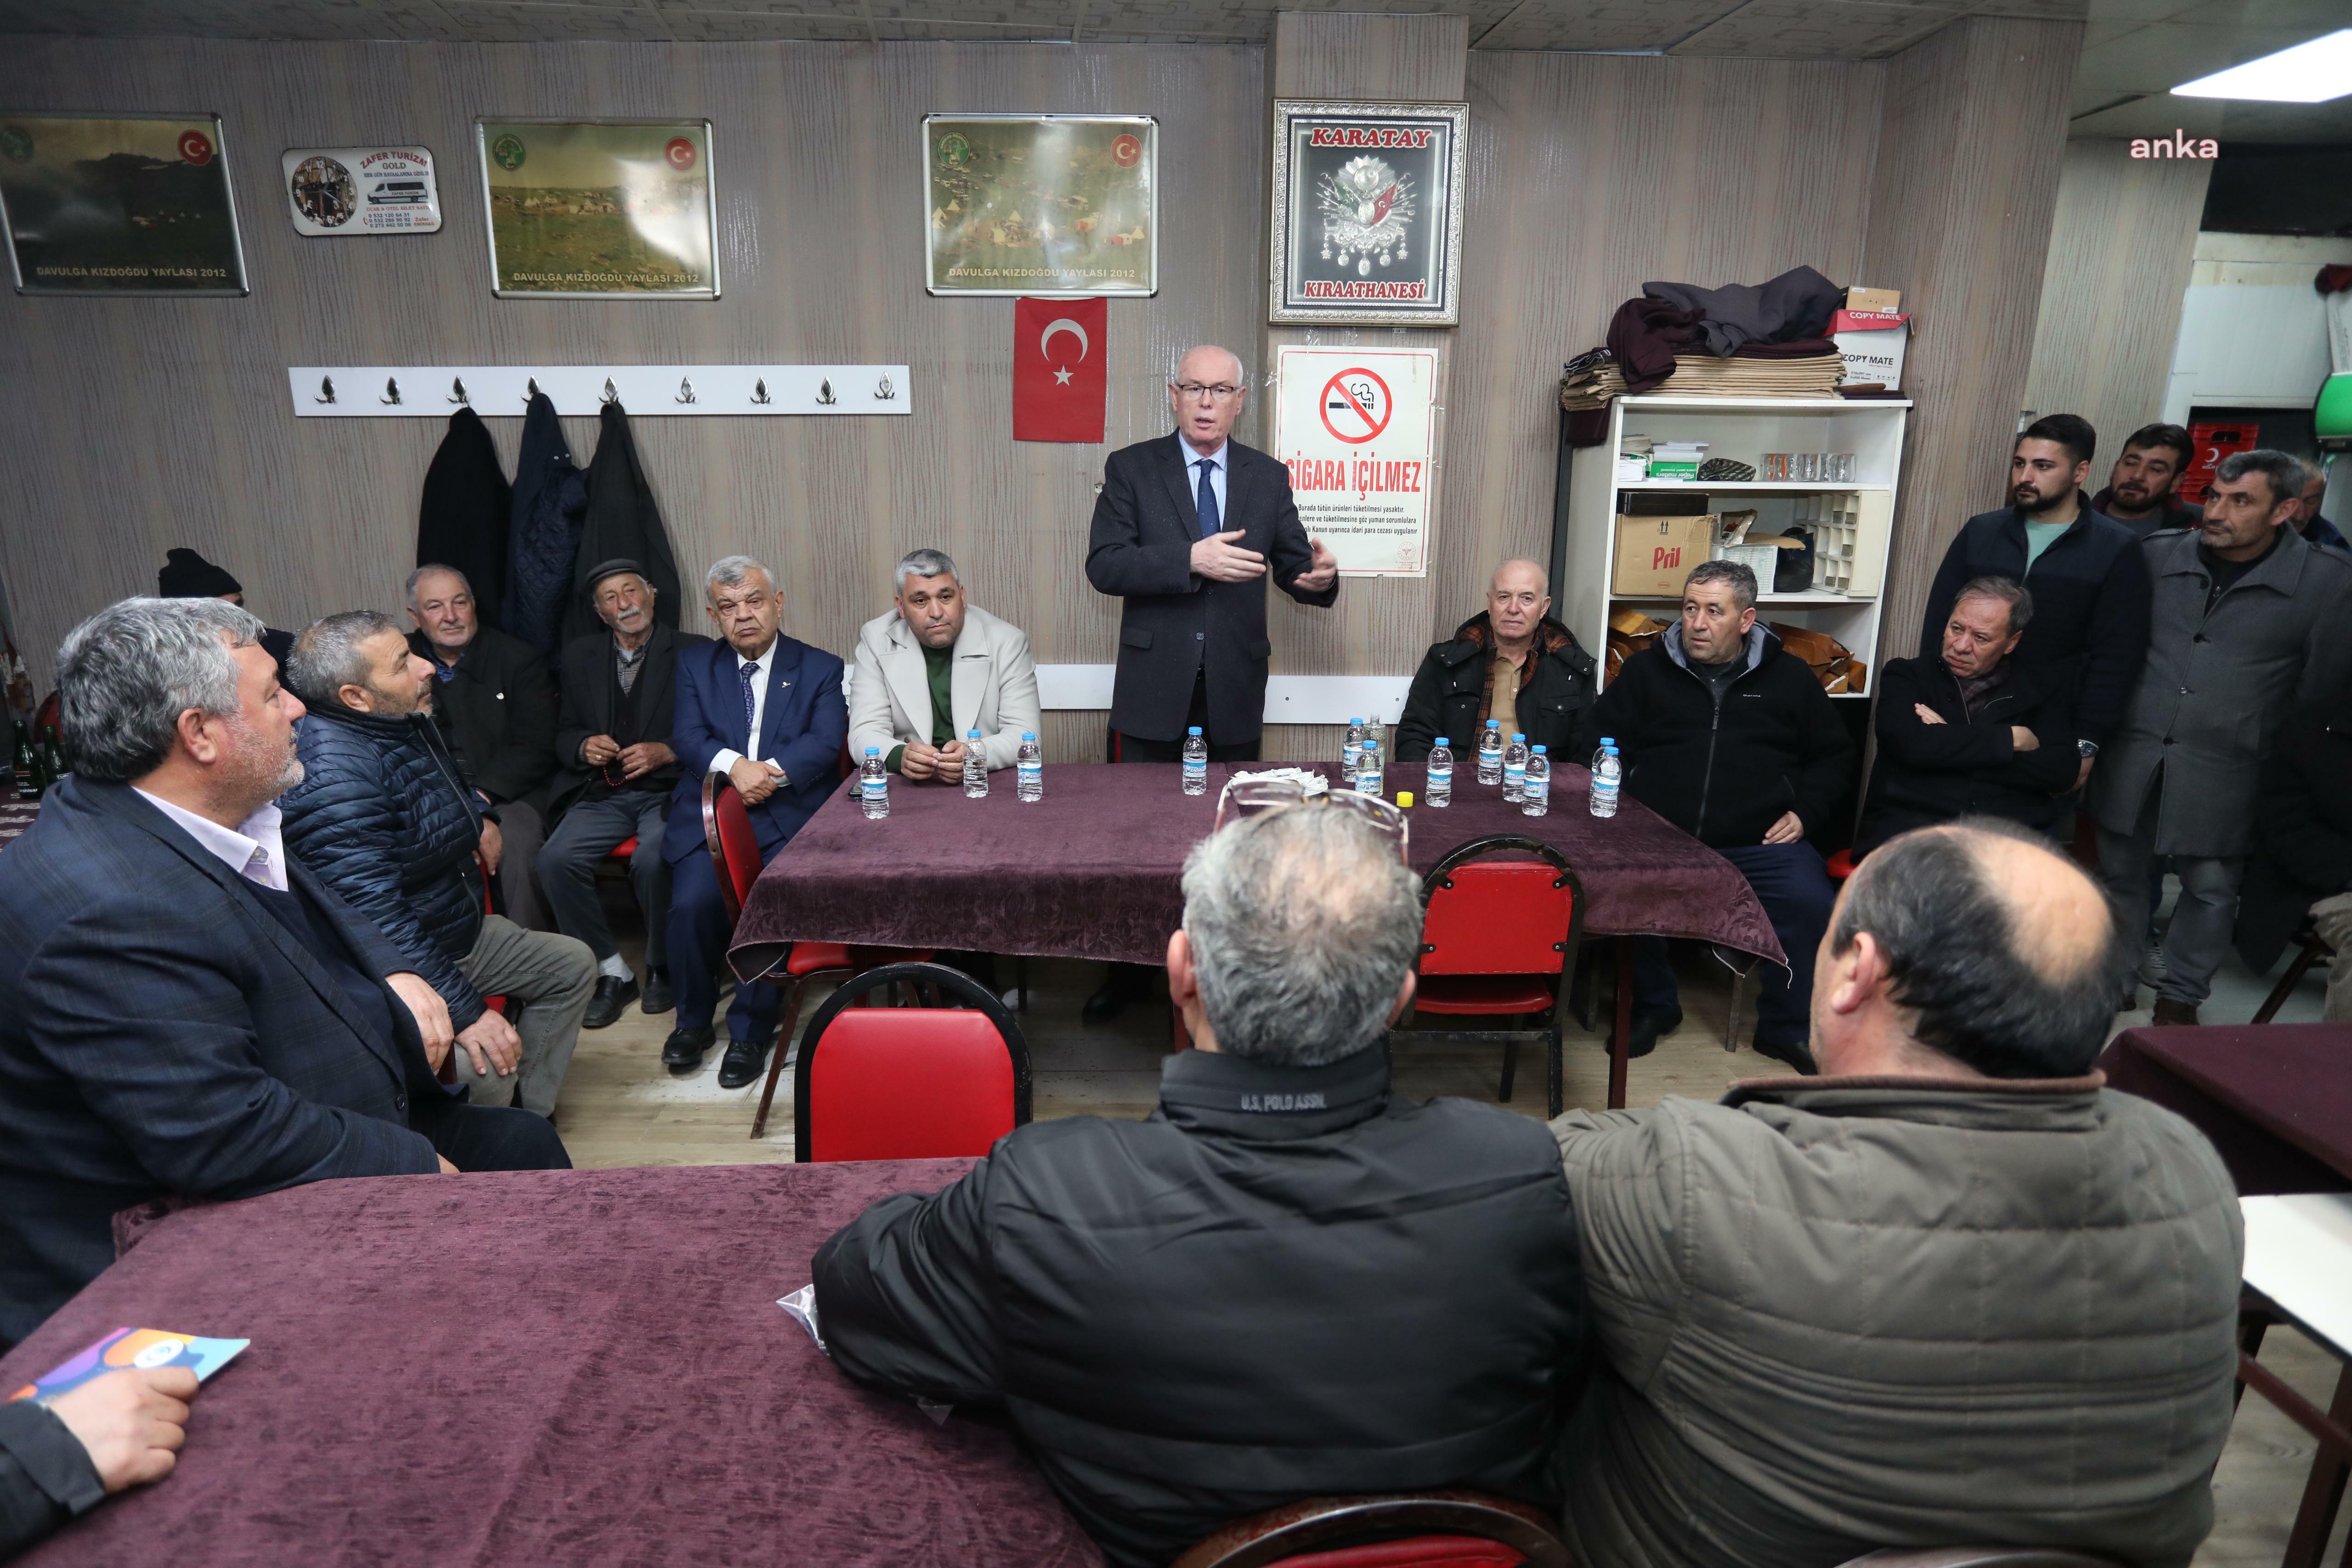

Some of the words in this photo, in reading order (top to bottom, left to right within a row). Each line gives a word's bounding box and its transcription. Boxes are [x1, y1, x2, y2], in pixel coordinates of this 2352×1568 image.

[1311, 128, 1431, 147] KARATAY
[360, 152, 389, 169] ZAFER
[390, 151, 427, 167] TURİZM
[327, 215, 333, 224] 6
[36, 267, 88, 276] DAVULGA
[91, 266, 148, 276] KIZDOĞDU
[152, 268, 197, 276] YAYLASI
[514, 273, 563, 281] DAVULGA
[566, 272, 622, 282] KIZDOĞDU
[626, 274, 670, 282] YAYLASI
[949, 268, 999, 276] DAVULGA
[1002, 267, 1058, 276] KIZDOĞDU
[1063, 269, 1107, 277] YAYLASI
[1110, 269, 1135, 277] 2012
[1305, 280, 1425, 298] KIRAATHANESİ
[1869, 356, 1894, 365] MATE
[1286, 451, 1346, 491] SİGARA
[1352, 451, 1421, 501] İÇİLMEZ
[1359, 515, 1367, 524] göz
[1653, 547, 1680, 570] Pril
[1241, 1095, 1262, 1112] U.S.
[1264, 1094, 1293, 1112] POLO
[1294, 1092, 1327, 1111] ASSN.
